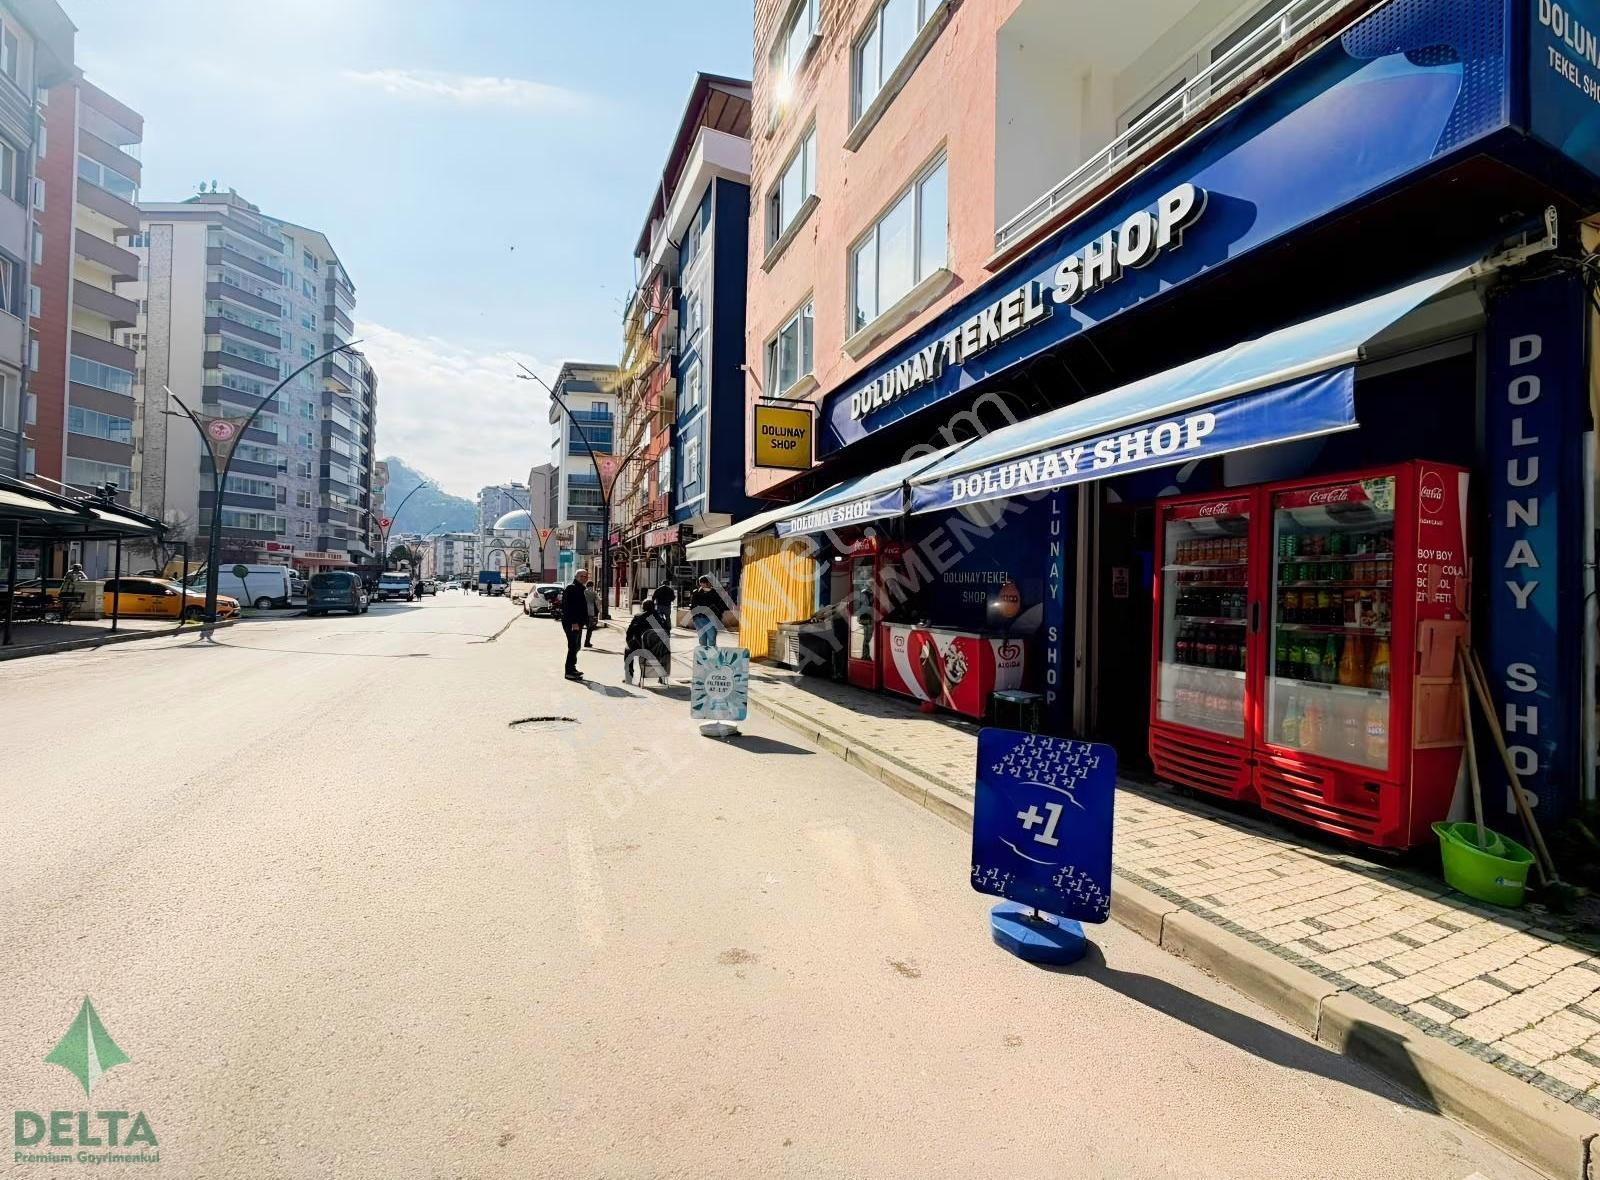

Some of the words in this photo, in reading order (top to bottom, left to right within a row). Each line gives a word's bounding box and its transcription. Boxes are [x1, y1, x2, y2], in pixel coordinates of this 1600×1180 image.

[1539, 0, 1600, 69] DOLUN
[1548, 46, 1581, 88] TEKEL
[850, 341, 943, 421] DOLUNAY
[946, 280, 1046, 365] TEKEL
[1052, 182, 1198, 304] SHOP
[762, 425, 805, 439] DOLUNAY
[771, 439, 797, 450] SHOP
[951, 446, 1084, 501] DOLUNAY
[1093, 412, 1216, 469] SHOP
[1504, 334, 1542, 610] DOLUNAY
[790, 509, 836, 533] DOLUNAY
[838, 500, 872, 522] SHOP
[1417, 549, 1434, 559] BOY
[1436, 550, 1453, 561] BOY
[943, 572, 981, 583] DOLUNAY
[982, 571, 1012, 584] TEKEL
[962, 591, 986, 604] SHOP
[1047, 626, 1058, 704] SHOP
[1505, 662, 1539, 816] SHOP
[1017, 802, 1063, 847] +1
